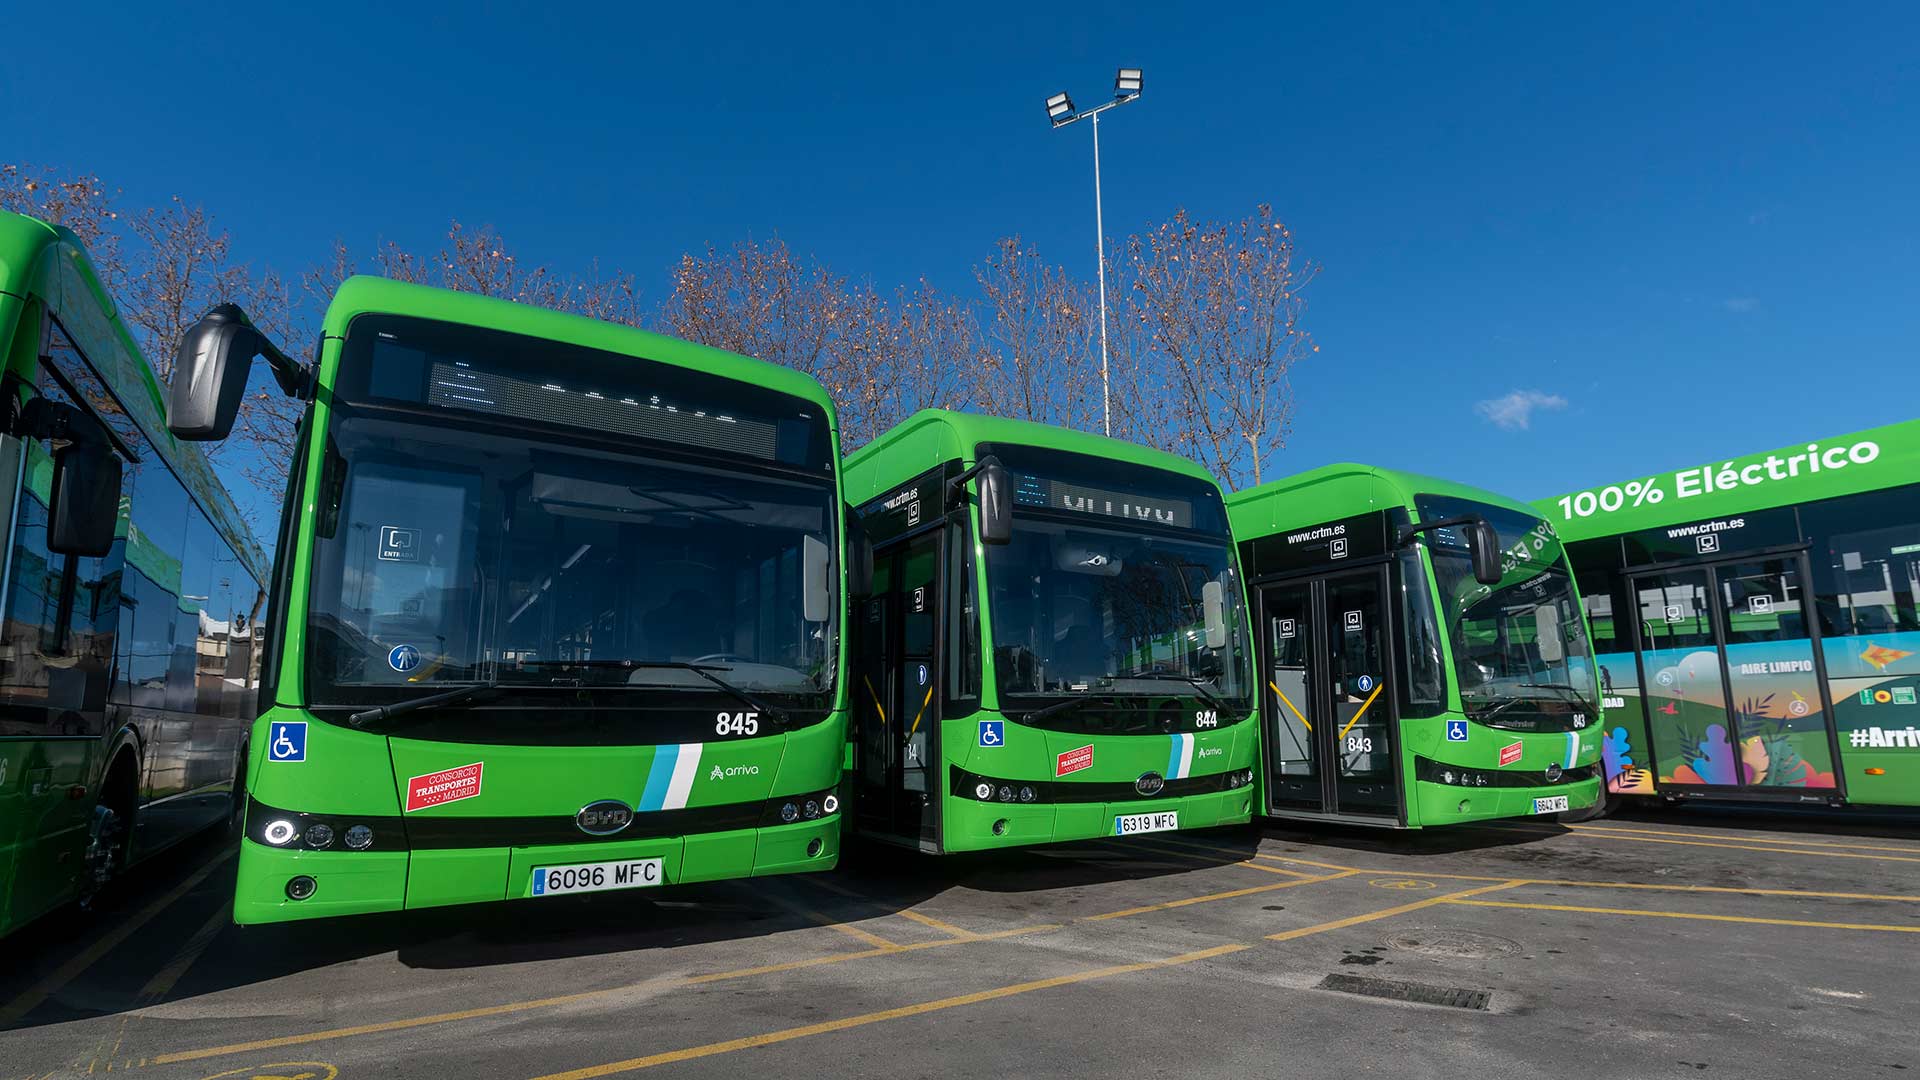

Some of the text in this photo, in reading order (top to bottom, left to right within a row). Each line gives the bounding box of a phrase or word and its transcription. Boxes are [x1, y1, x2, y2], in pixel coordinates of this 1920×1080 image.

[1558, 441, 1880, 520] 100% Eléctrico
[1287, 524, 1345, 544] www.crtm.es
[1667, 518, 1745, 538] www.crtm.es
[383, 550, 414, 558] ENTRADA
[1741, 659, 1813, 675] AIRE LIMPIO
[715, 712, 759, 735] 845
[1196, 710, 1217, 728] 844
[1573, 713, 1586, 728] 843
[1347, 737, 1372, 752] 843
[428, 766, 478, 785] CONSORCIO
[725, 764, 760, 776] arriva
[415, 776, 477, 797] TRANSPORTES
[442, 786, 476, 801] MADRID
[1123, 814, 1175, 831] 6319 MFC
[548, 862, 656, 890] 6096 MFC
